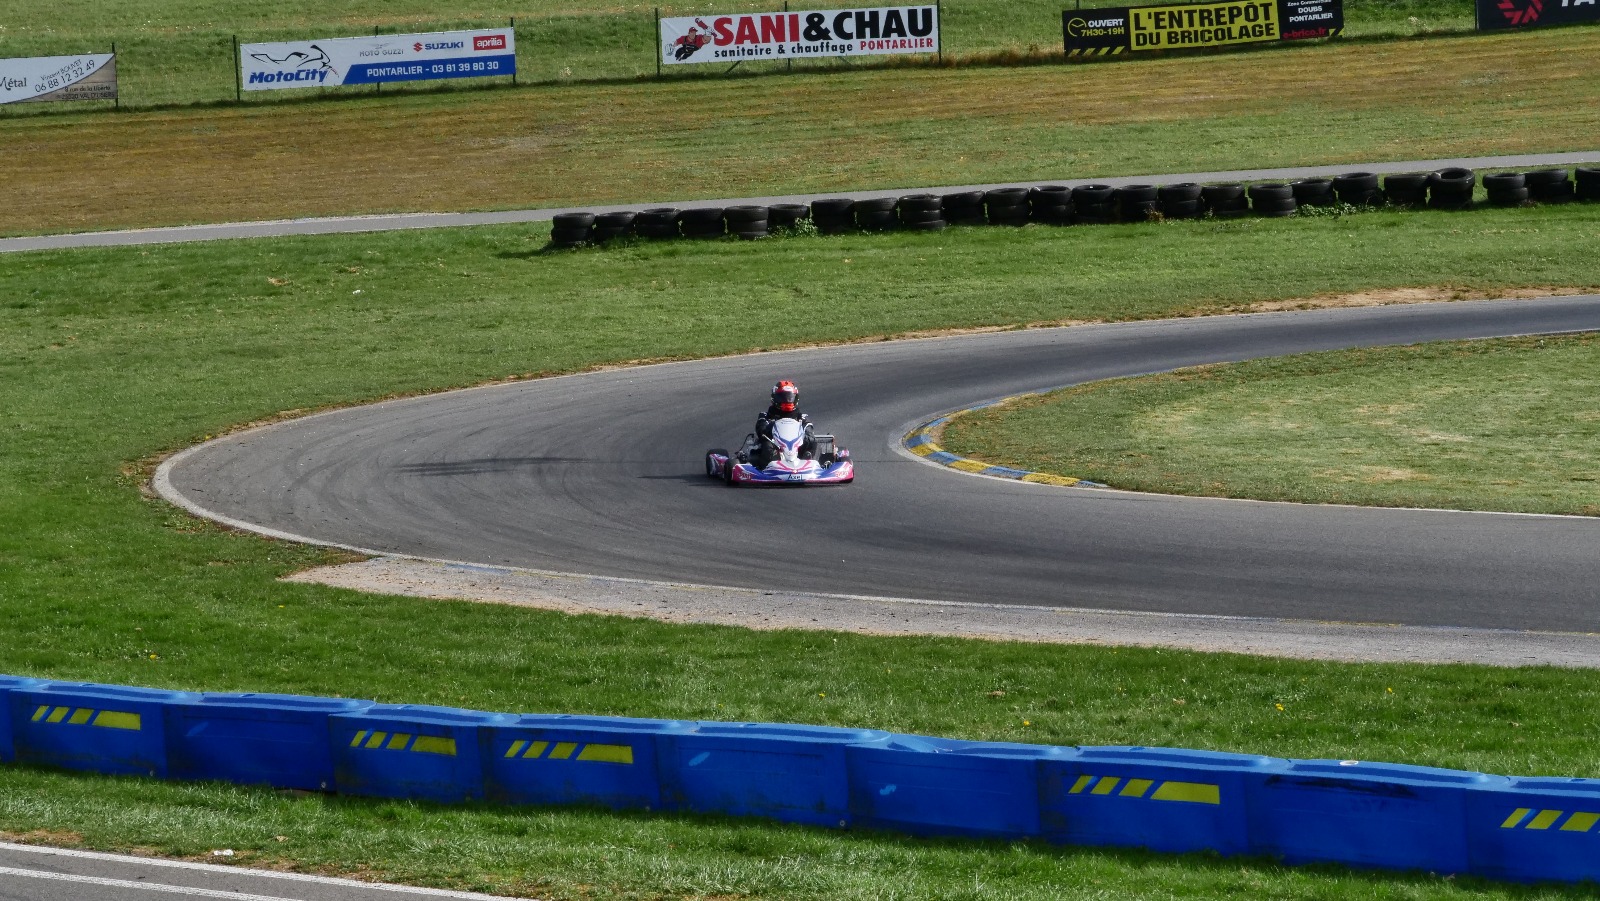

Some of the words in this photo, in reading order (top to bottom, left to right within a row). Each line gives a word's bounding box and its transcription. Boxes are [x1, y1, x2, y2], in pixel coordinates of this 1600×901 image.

[1298, 5, 1323, 14] DOUBS
[1134, 2, 1273, 31] L'ENTREPÔT
[1289, 12, 1333, 23] PONTARLIER
[1087, 18, 1124, 28] OUVERT
[1081, 27, 1125, 37] 7H30-19H
[1135, 31, 1161, 47] DU
[1167, 22, 1276, 45] BRICOLAGE
[1282, 27, 1326, 39] e-brico.fr
[424, 41, 464, 51] SUZUKI
[476, 37, 503, 48] aprilia
[714, 45, 772, 58] sanitaire
[777, 44, 786, 55] &
[791, 42, 853, 54] chauffage
[860, 38, 934, 51] PONTARLIER
[359, 49, 380, 57] MOTO
[381, 48, 404, 56] GUZZI
[367, 65, 423, 77] PONTARLIER
[432, 63, 444, 73] 03
[446, 62, 456, 72] 81
[458, 61, 471, 72] 39
[486, 61, 499, 70] 30
[34, 84, 47, 93] 06
[48, 78, 60, 89] 88
[60, 73, 72, 83] 12
[72, 67, 85, 79] 32
[86, 59, 95, 72] 49
[249, 68, 328, 84] MotoCity
